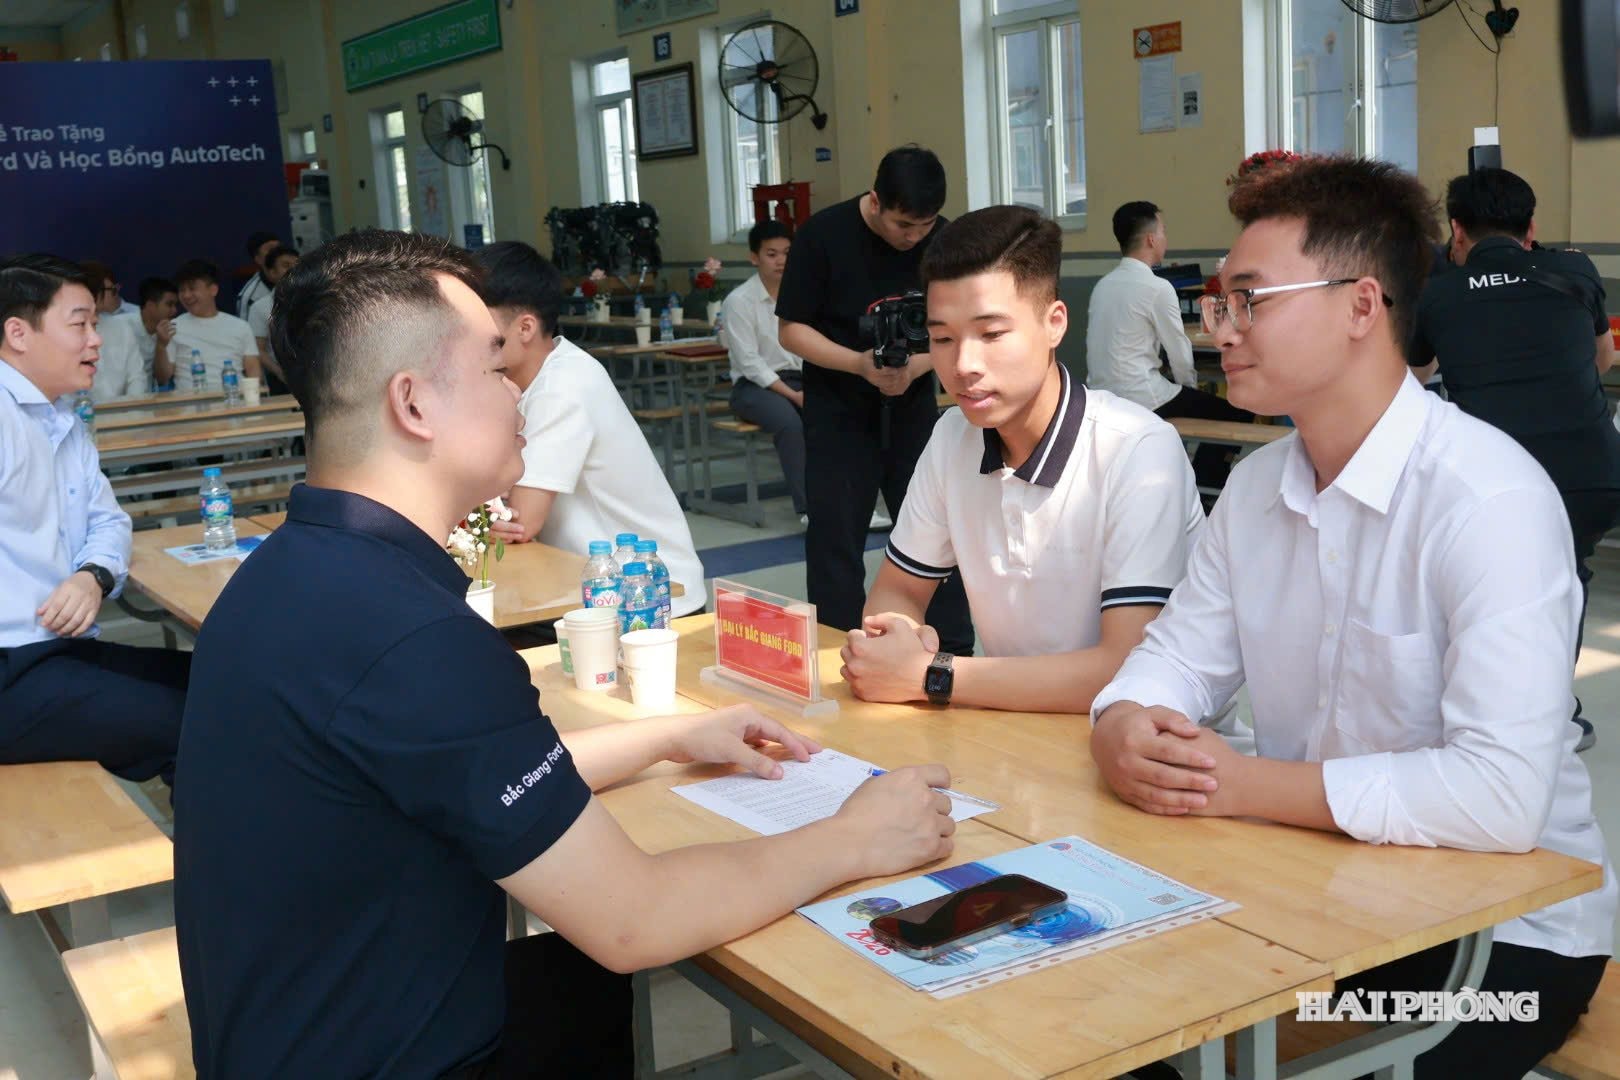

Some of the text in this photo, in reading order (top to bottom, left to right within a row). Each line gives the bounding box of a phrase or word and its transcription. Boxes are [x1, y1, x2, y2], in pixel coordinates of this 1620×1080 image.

[11, 126, 55, 142] Trao
[58, 125, 105, 143] Tặng
[23, 150, 53, 169] Và
[59, 150, 102, 172] Học
[170, 144, 266, 165] AutoTech
[760, 631, 783, 651] GIANG
[783, 640, 803, 657] FORD
[500, 741, 564, 807] Bắc Giang Ford
